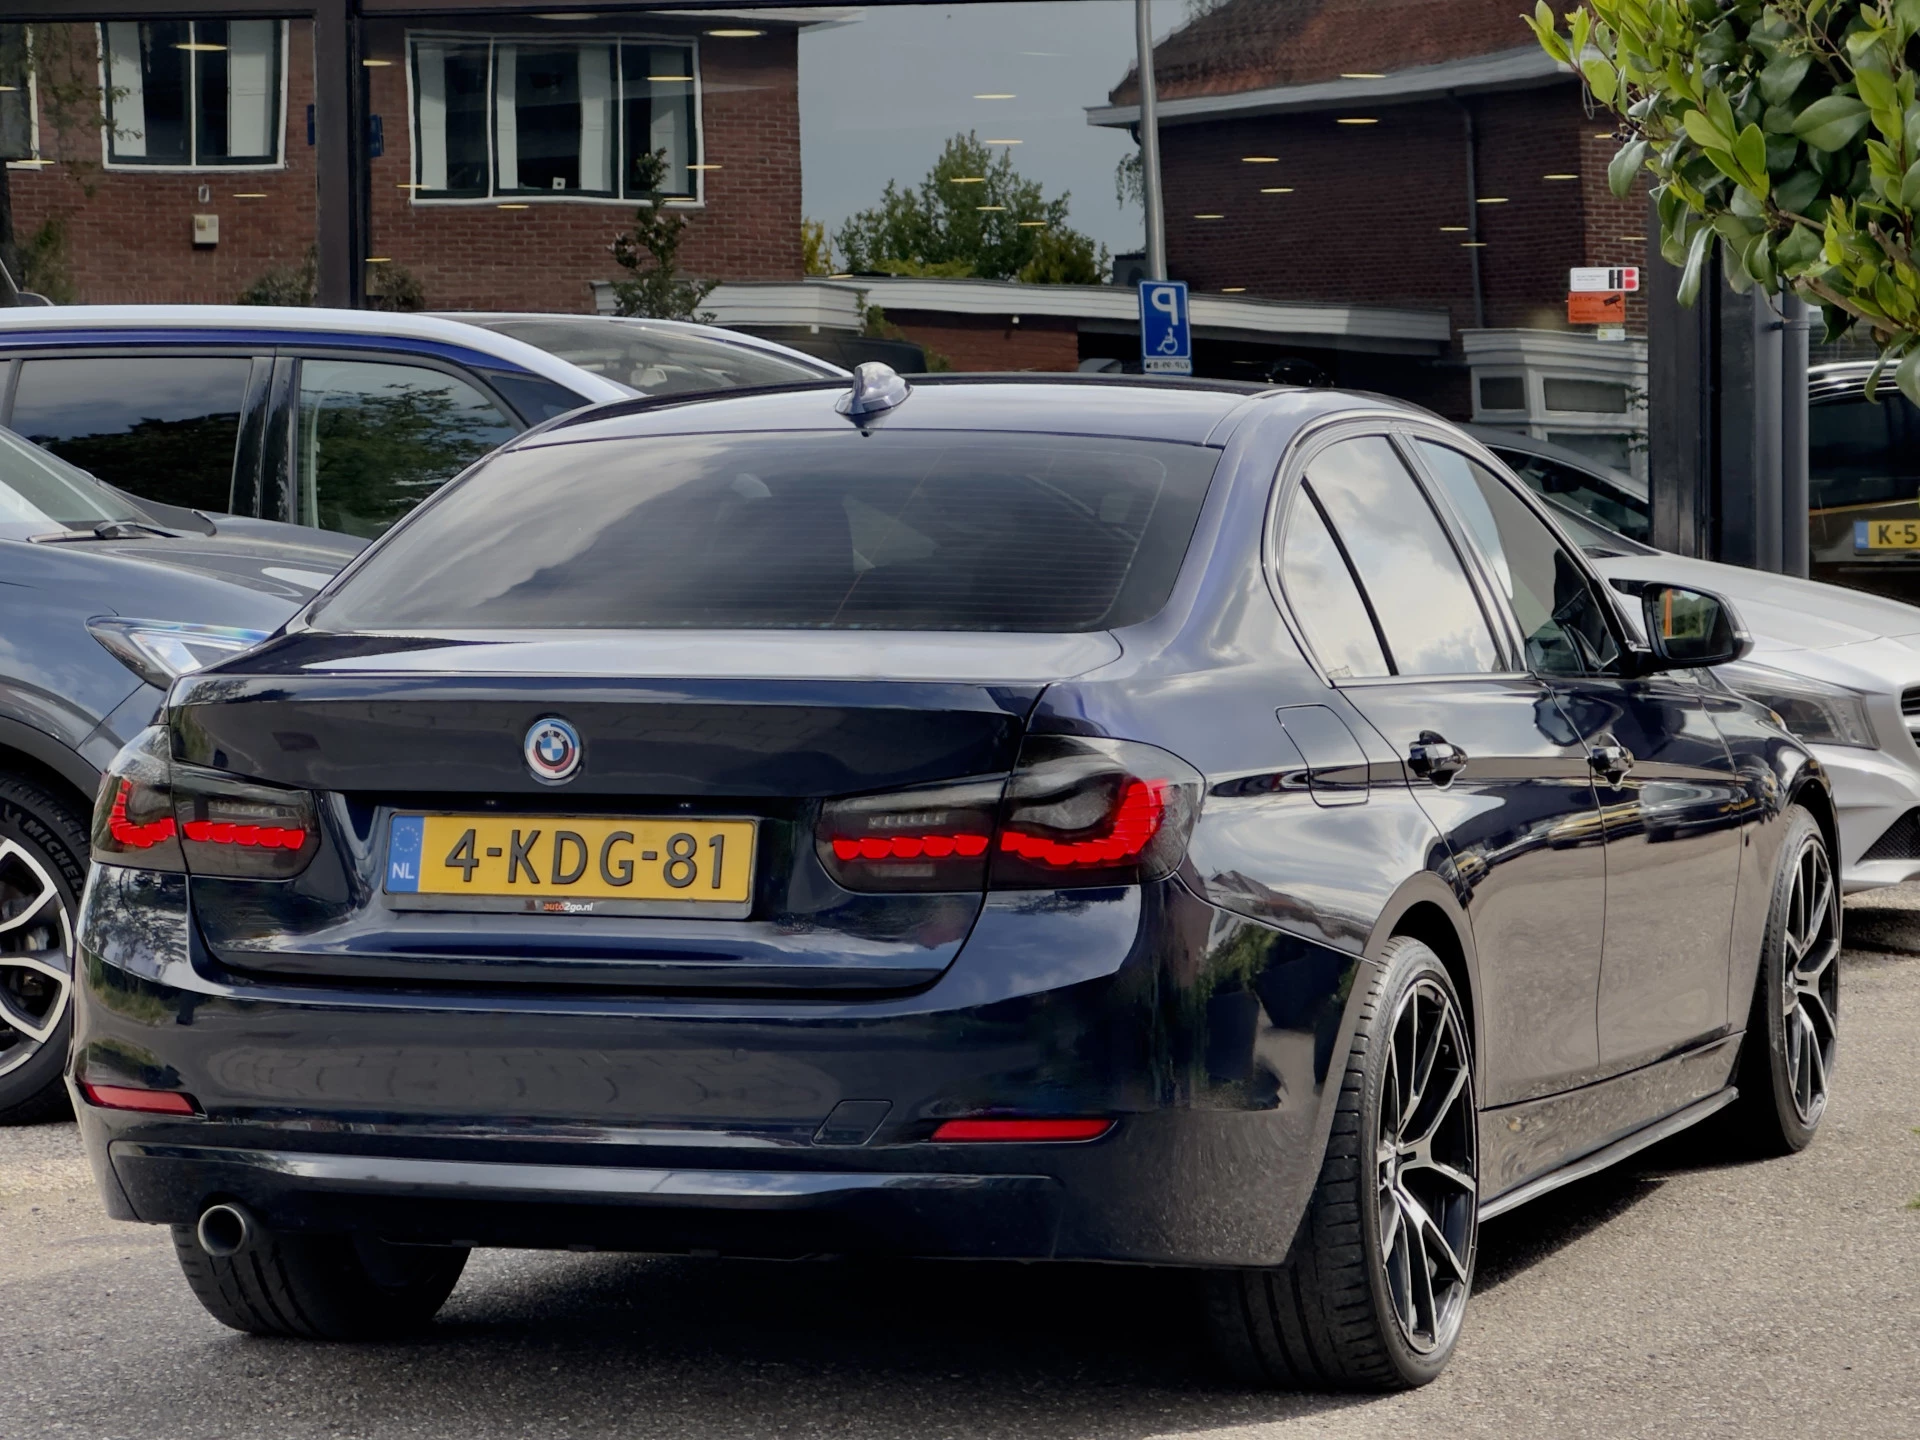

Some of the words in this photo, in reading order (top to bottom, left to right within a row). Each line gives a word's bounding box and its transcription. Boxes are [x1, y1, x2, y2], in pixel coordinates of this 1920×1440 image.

[1878, 524, 1918, 545] K-5
[445, 828, 725, 889] 4-KDG-81
[392, 862, 415, 879] NL
[543, 902, 594, 913] auto2go.nl
